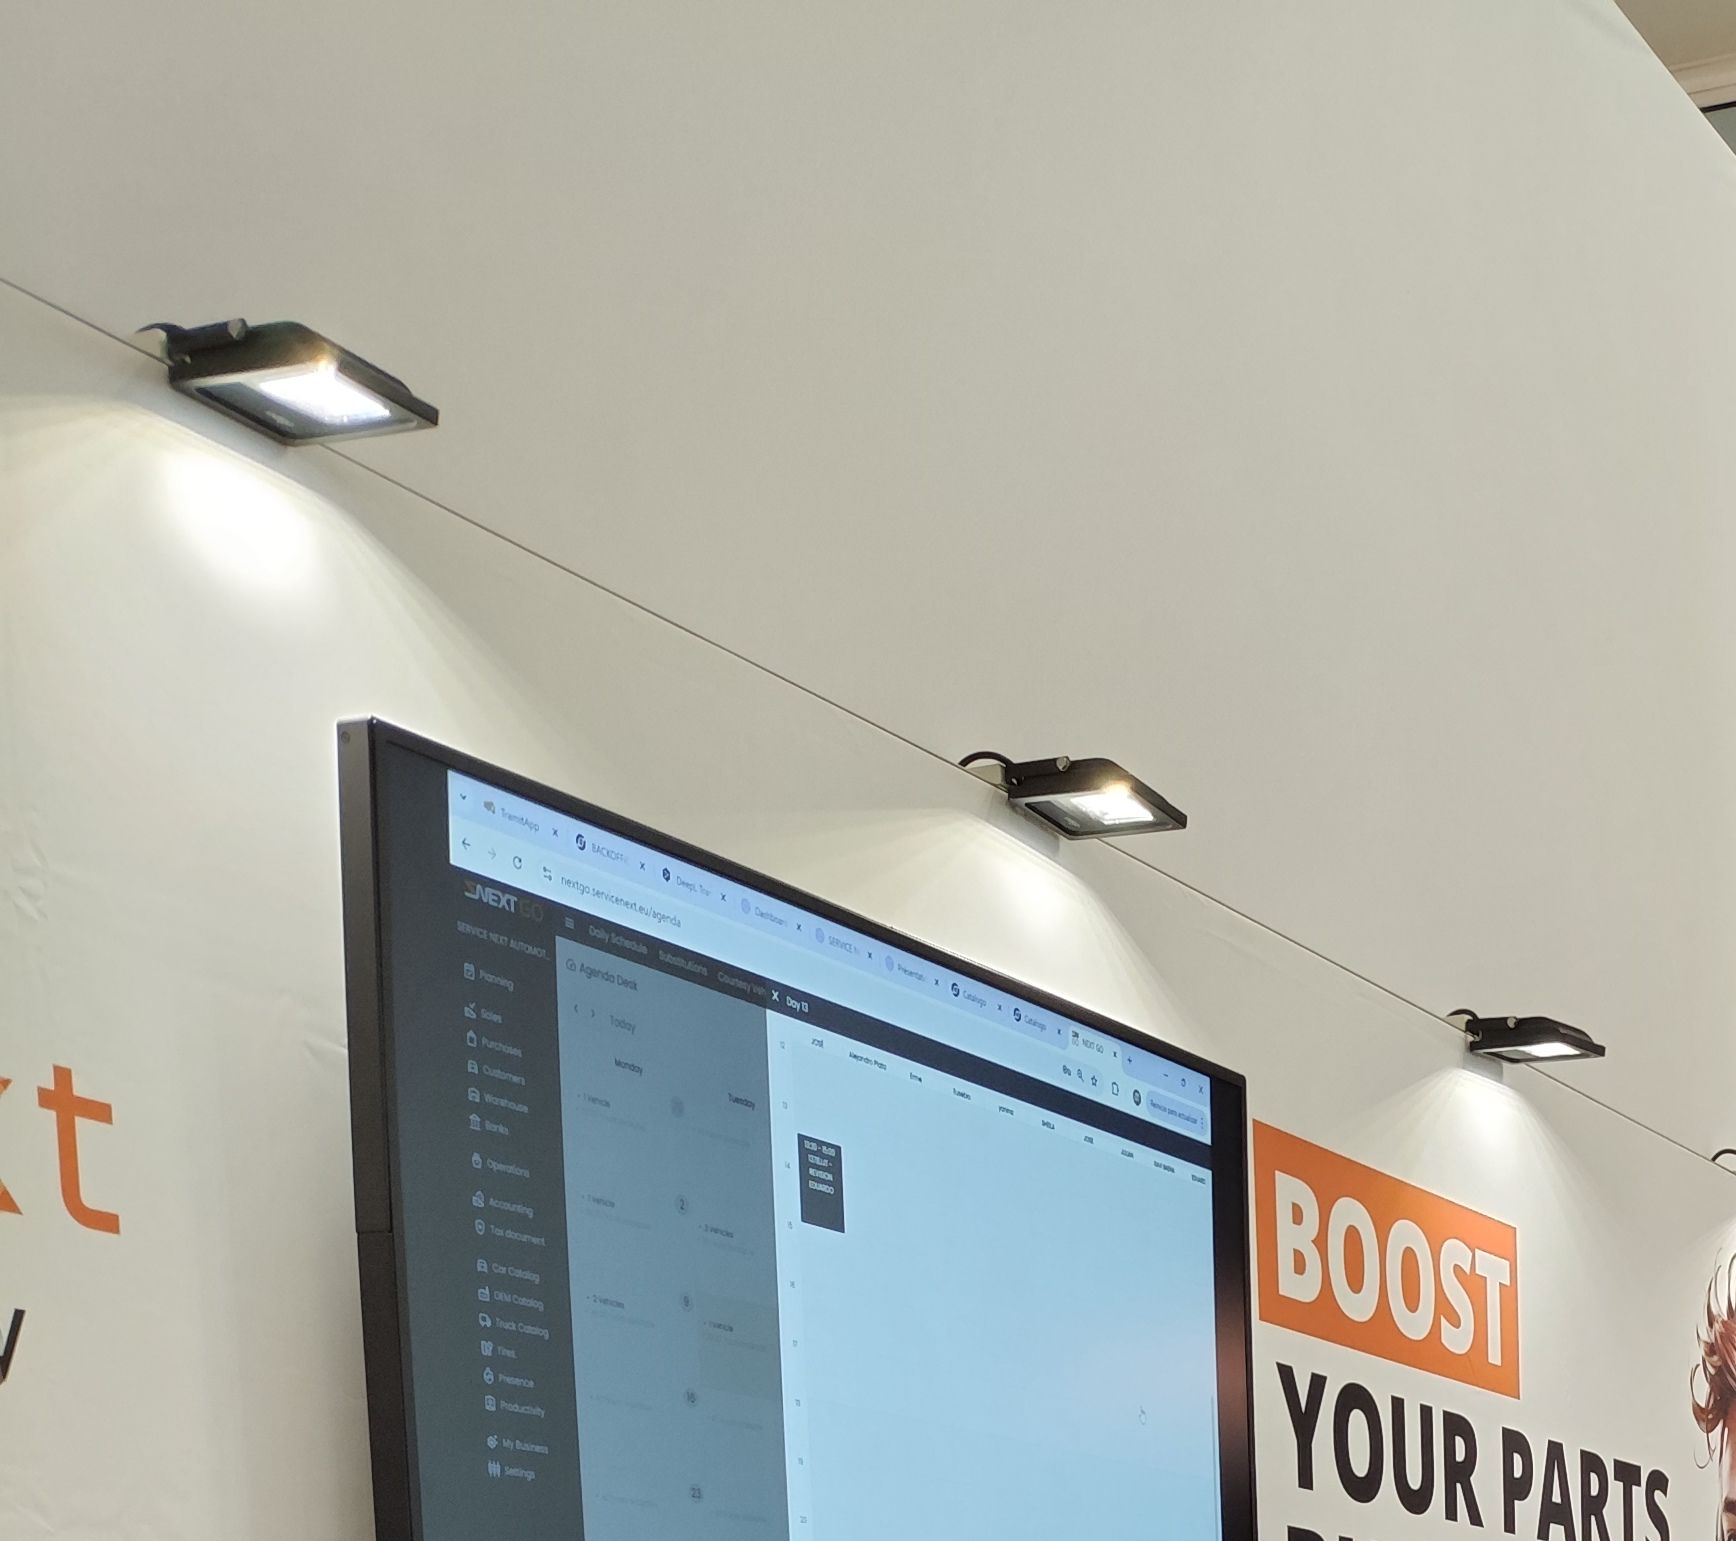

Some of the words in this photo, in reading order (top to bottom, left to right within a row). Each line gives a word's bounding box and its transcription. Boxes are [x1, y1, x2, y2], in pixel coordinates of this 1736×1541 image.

[579, 963, 616, 986] Agenda
[609, 1014, 637, 1036] Today
[1274, 1169, 1511, 1367] BOOST
[1275, 1361, 1484, 1528] YOUR
